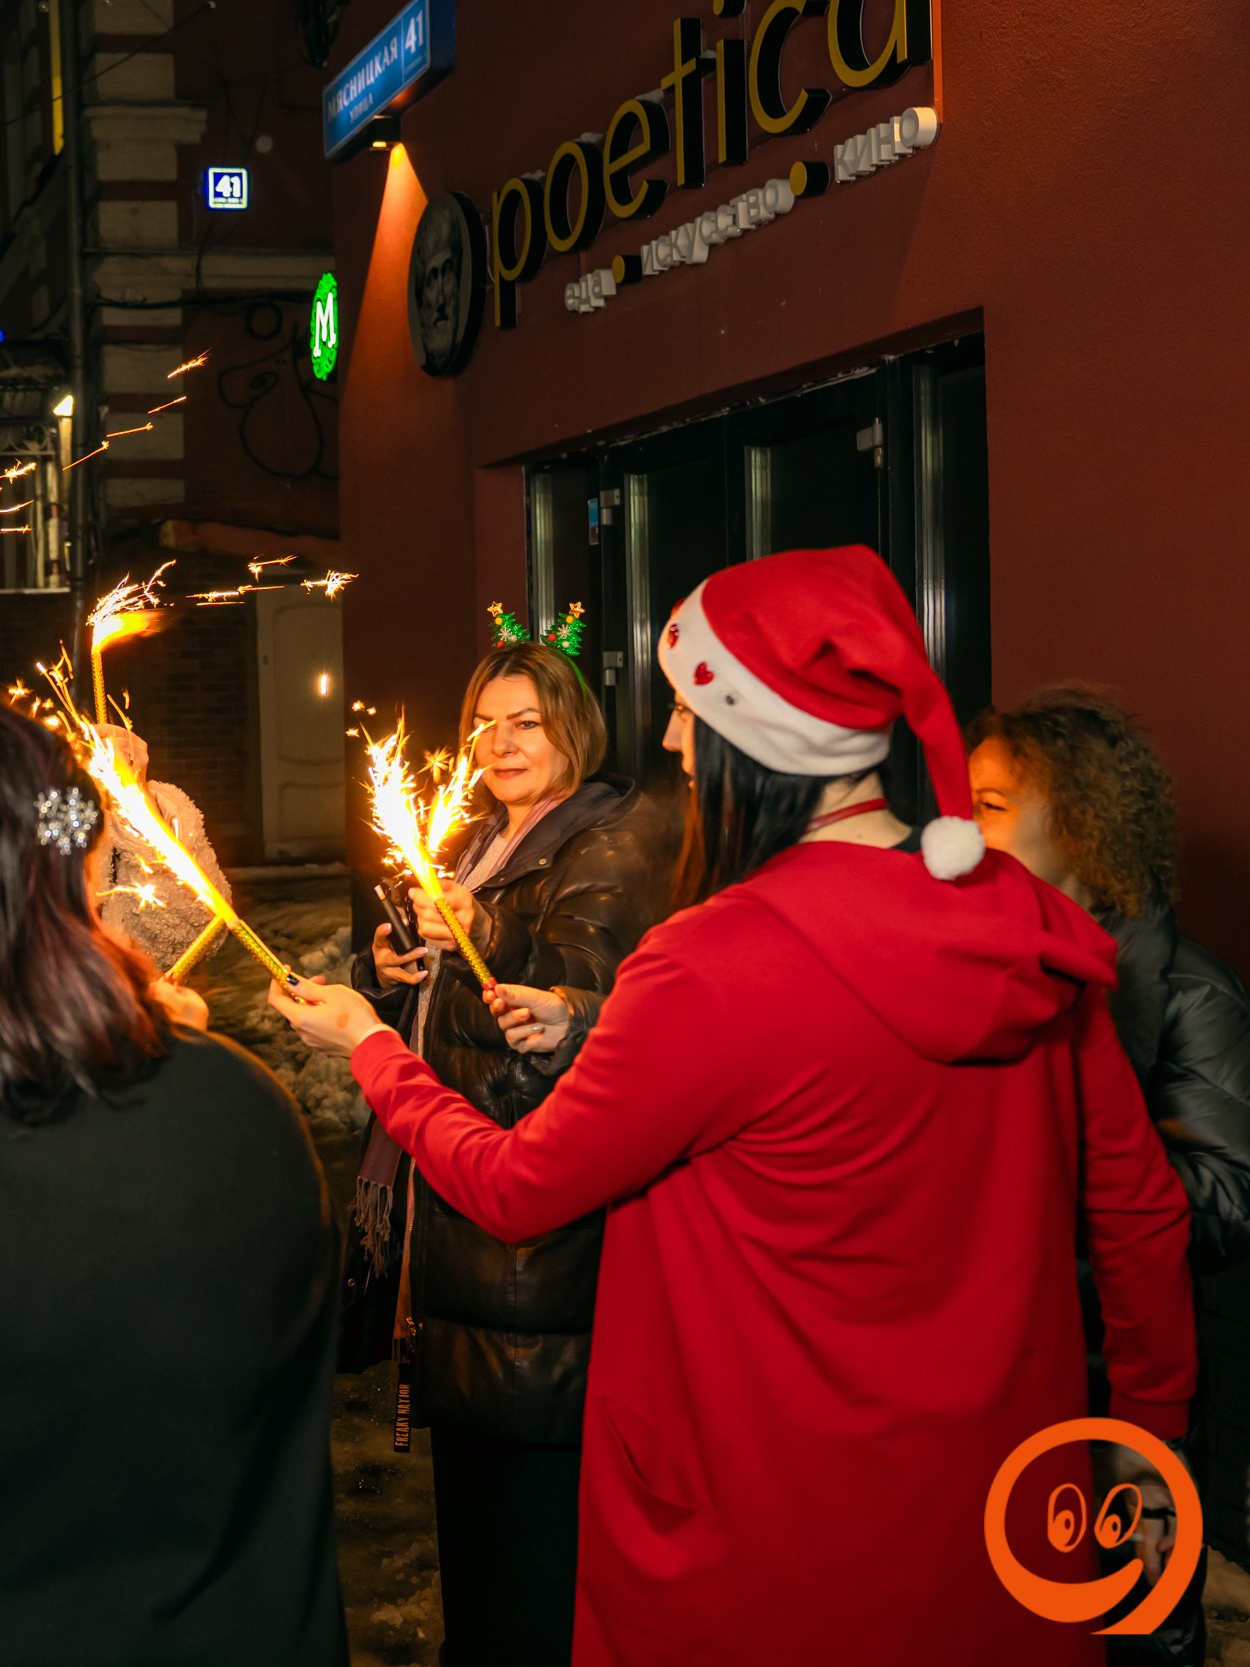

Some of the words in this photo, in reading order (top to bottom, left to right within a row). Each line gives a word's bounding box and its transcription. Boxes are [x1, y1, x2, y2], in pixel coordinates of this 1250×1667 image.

[328, 37, 398, 121] МЯСНИЦКАЯ
[405, 10, 424, 53] 41
[492, 0, 932, 328] poetica
[215, 174, 241, 198] 41
[397, 1384, 411, 1414] NATION
[395, 1416, 410, 1446] FREAKY
